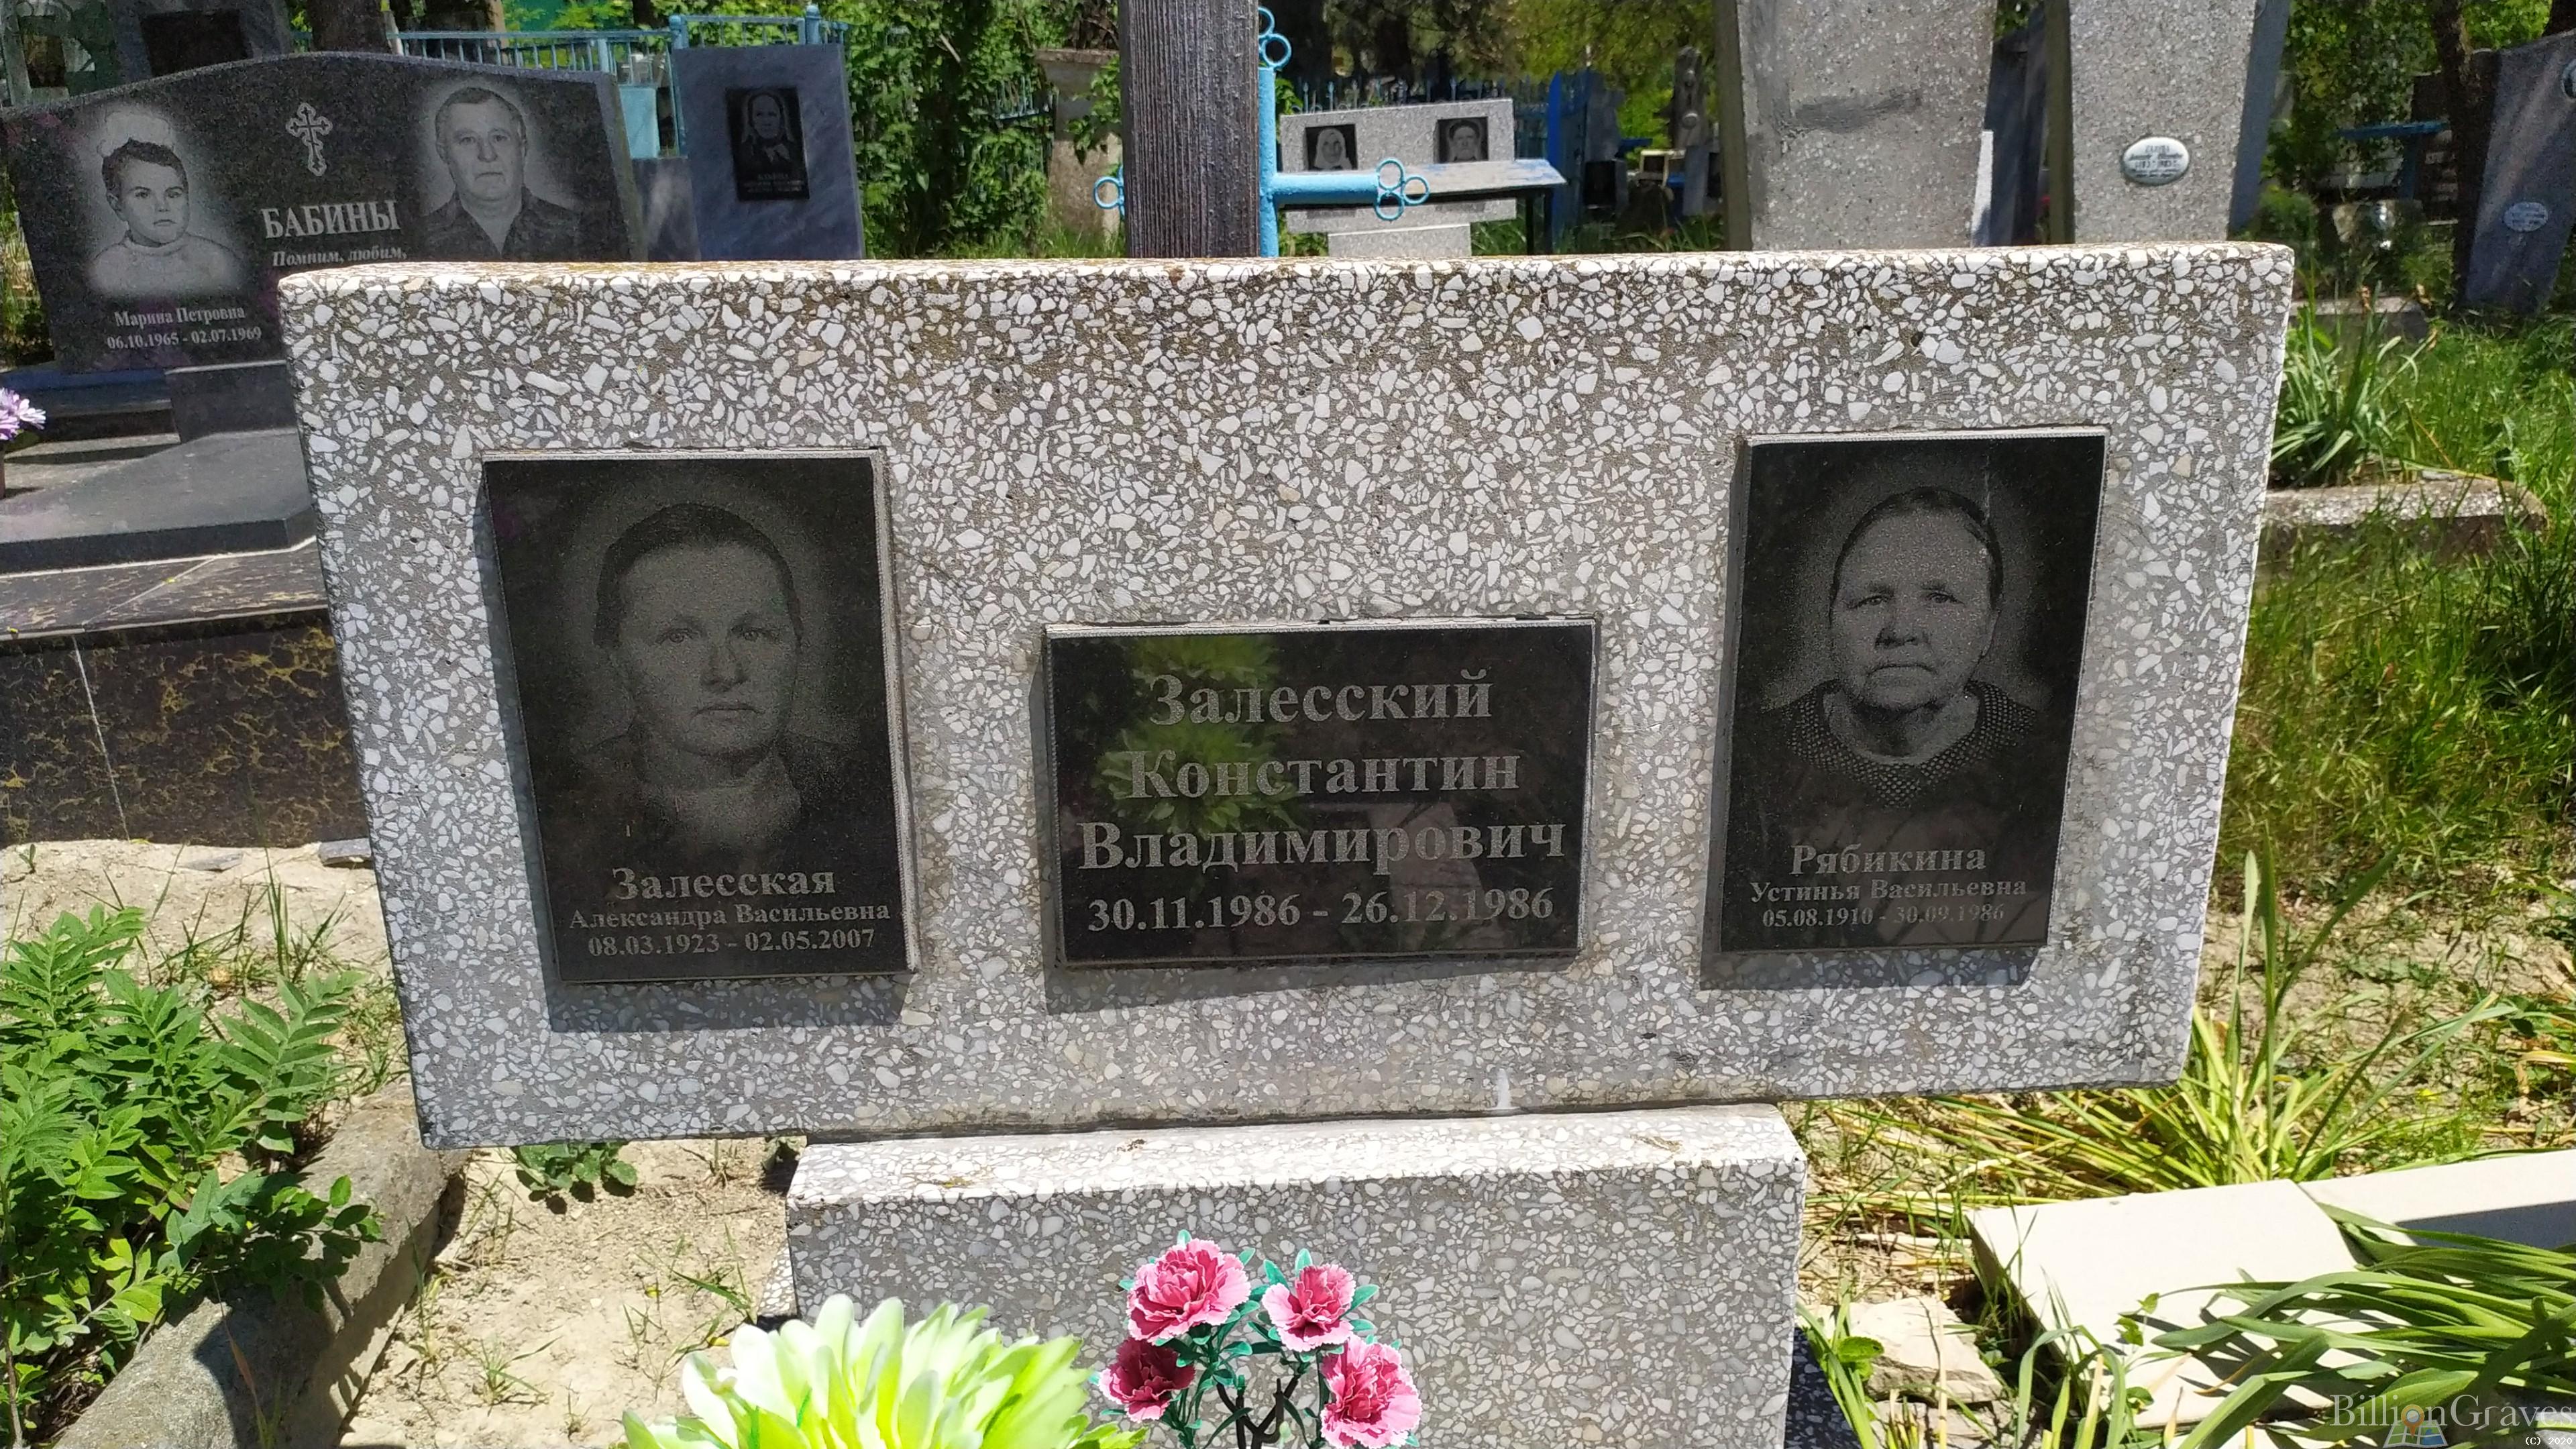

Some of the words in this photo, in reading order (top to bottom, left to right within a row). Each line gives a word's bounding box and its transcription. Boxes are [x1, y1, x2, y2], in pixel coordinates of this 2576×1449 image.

[261, 200, 400, 239] БАБИНЫ
[272, 250, 344, 267] Помним,
[347, 245, 408, 262] любим,
[113, 310, 174, 329] Марина
[176, 307, 246, 325] Петровна
[107, 332, 179, 350] 06.10.1965
[191, 326, 262, 343] 02.07.1969
[1149, 668, 1495, 726] Залесский
[1127, 748, 1521, 800] Константин
[1076, 820, 1567, 875] Владимирович
[1788, 843, 1987, 875] Рябикина
[612, 867, 836, 901] Залесская
[1750, 881, 1862, 904] Устинья
[1870, 878, 2027, 900] Васильевна
[568, 908, 727, 930] Александра
[734, 902, 891, 924] Васильевна
[1087, 893, 1302, 932] 30.11.1986
[1341, 887, 1555, 924] 26.12.1986
[1762, 906, 1874, 928] 05.08.1910
[1895, 903, 2005, 924] 30.09.1986
[588, 932, 720, 957] 08.03.1923
[745, 928, 875, 953] 02.05.2007
